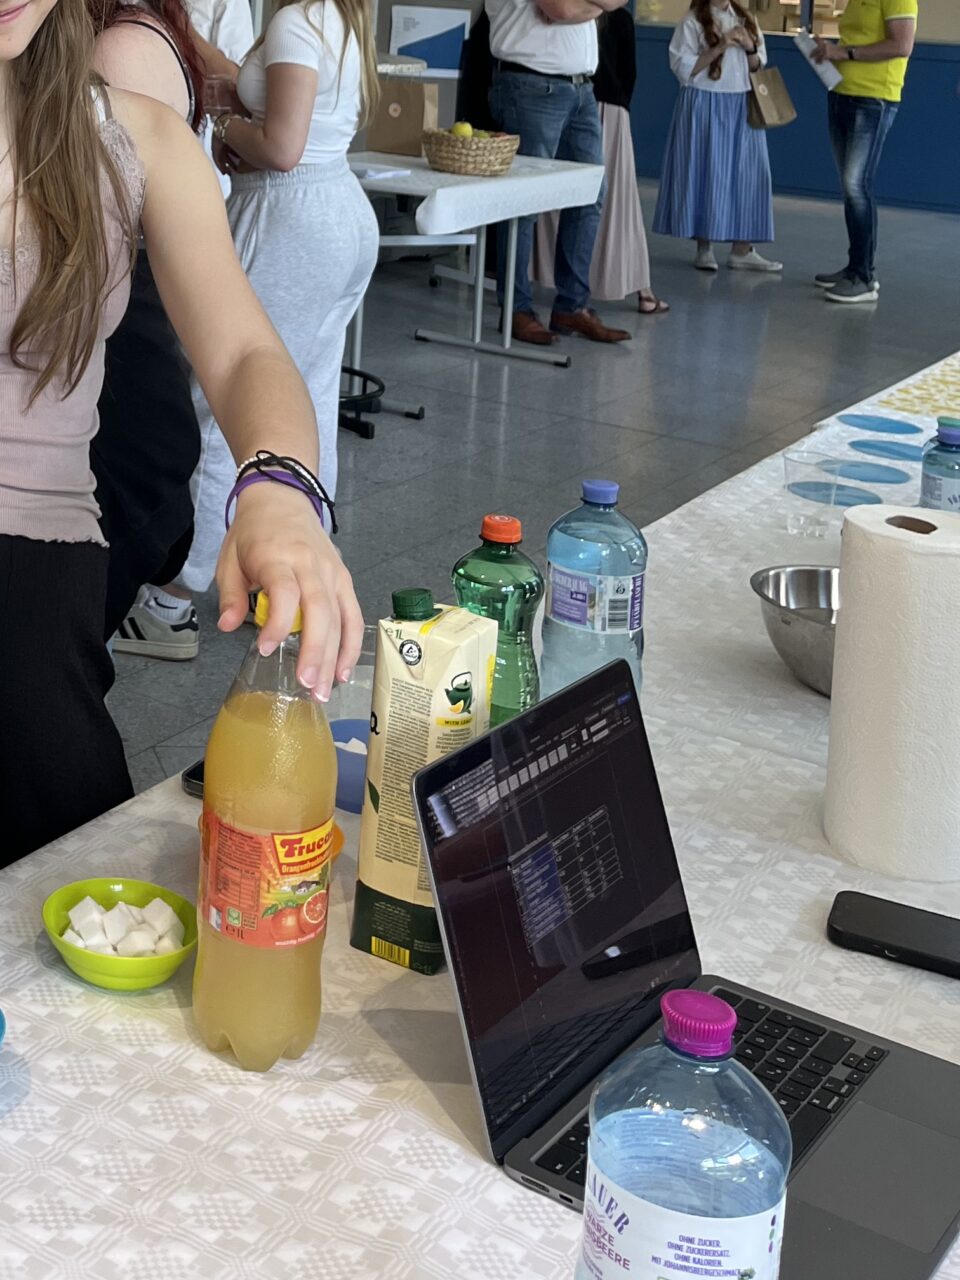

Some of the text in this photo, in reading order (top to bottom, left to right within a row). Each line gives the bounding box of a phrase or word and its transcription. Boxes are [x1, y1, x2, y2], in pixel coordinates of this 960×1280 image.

[395, 629, 405, 640] 1L
[678, 1234, 695, 1245] OHNE
[667, 1241, 684, 1252] OHNE
[651, 1255, 662, 1265] MIT
[674, 1253, 691, 1264] OHNE
